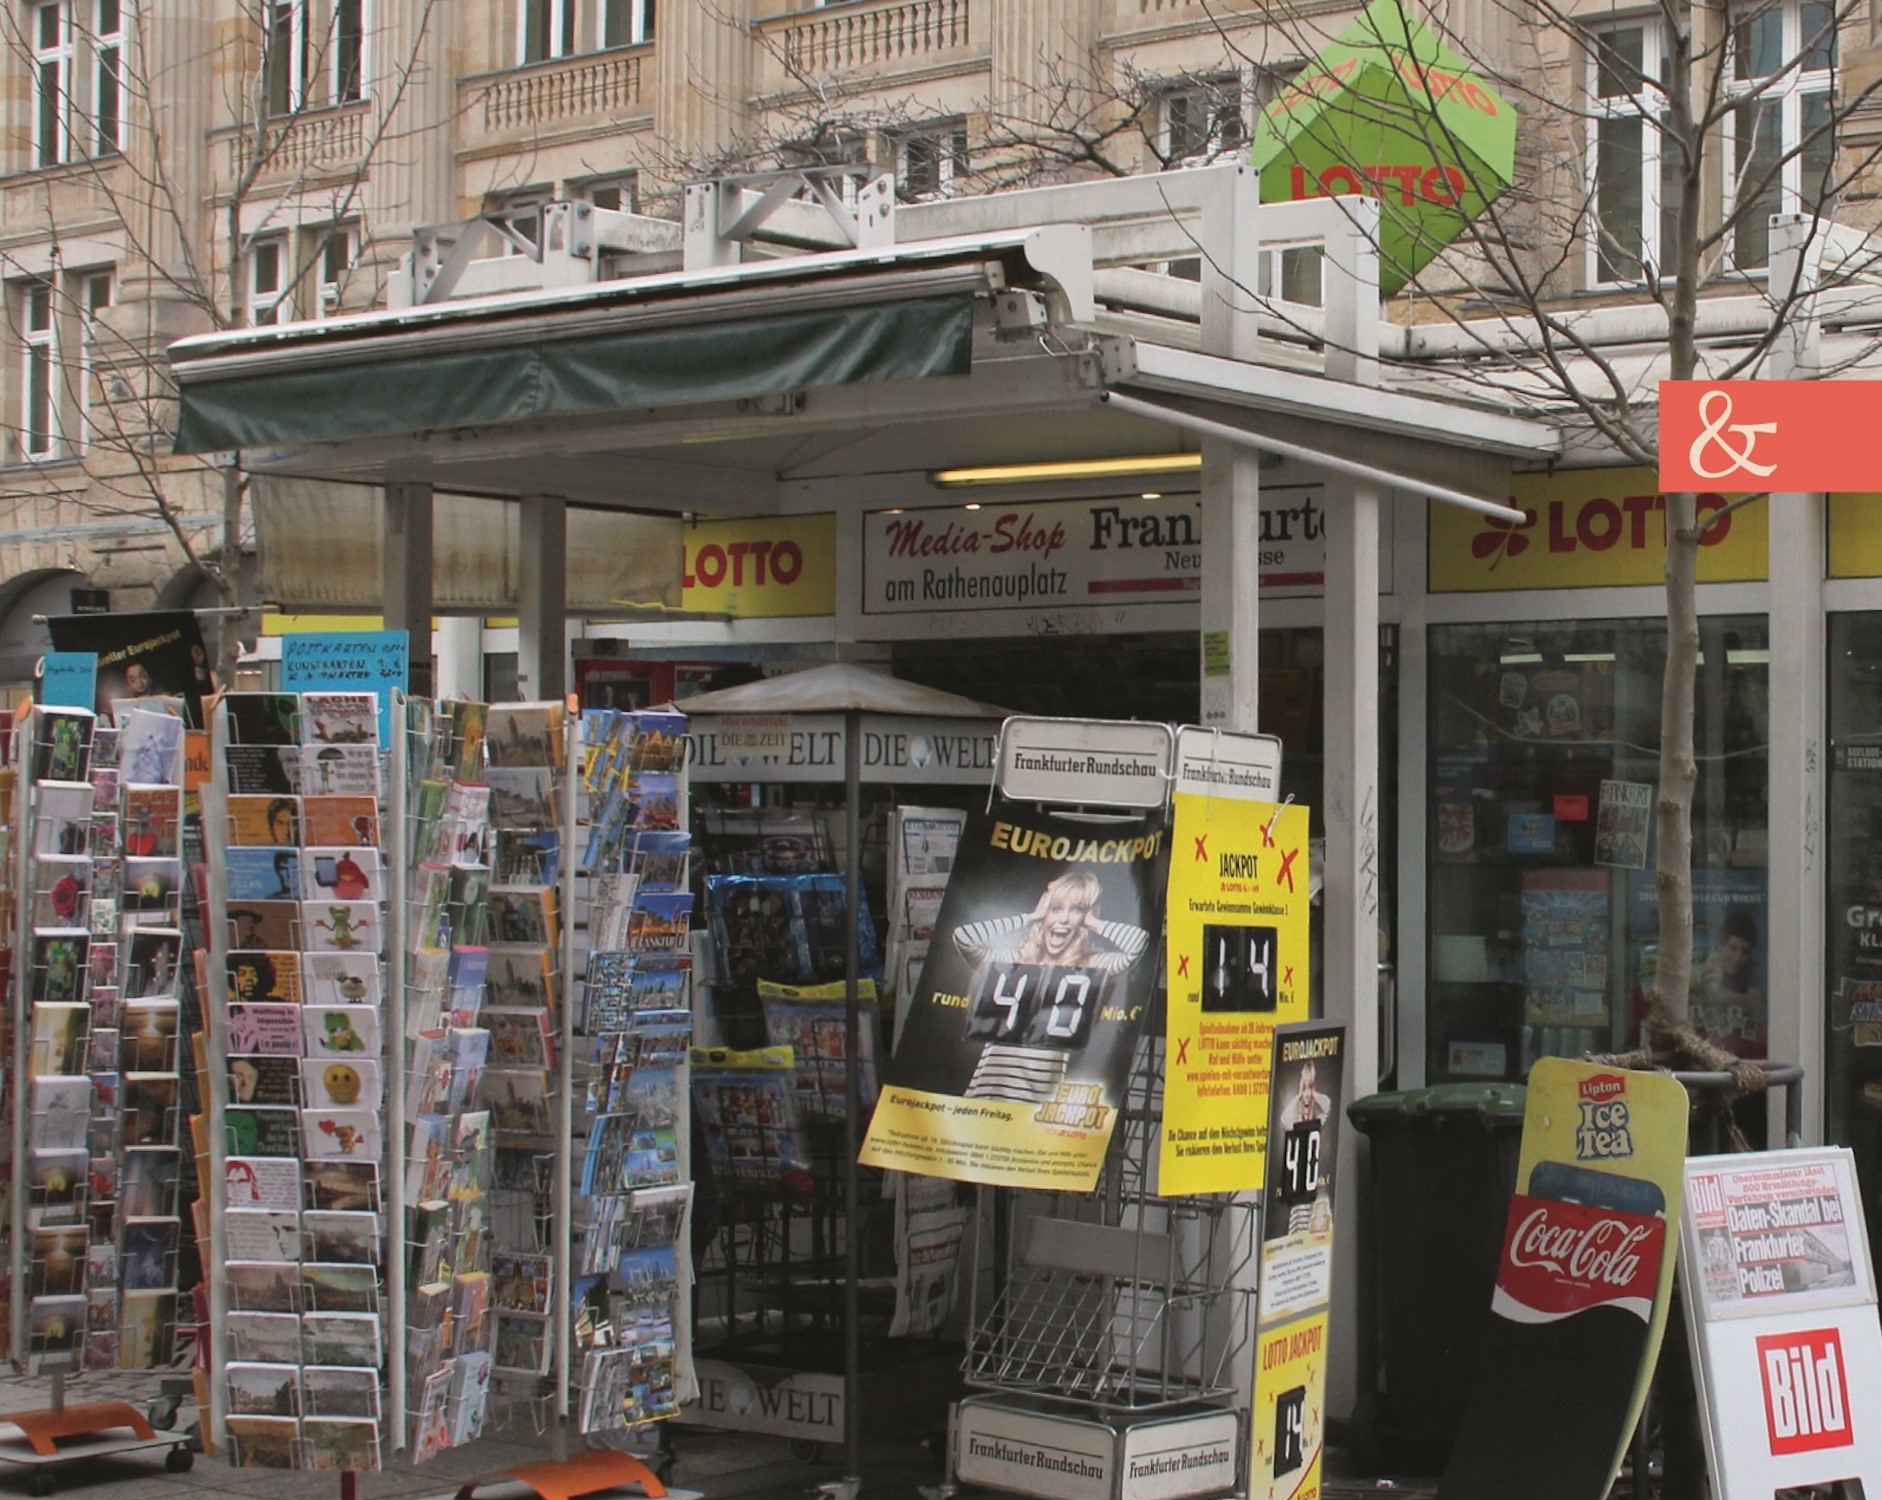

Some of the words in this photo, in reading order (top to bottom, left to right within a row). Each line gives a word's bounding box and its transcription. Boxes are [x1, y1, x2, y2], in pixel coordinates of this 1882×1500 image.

[1391, 55, 1498, 117] LOTTO
[1290, 164, 1465, 207] LOTTO
[885, 513, 1067, 561] Media-Shop
[682, 540, 803, 588] LOTTO
[1164, 551, 1201, 570] Neu
[886, 579, 915, 601] am
[923, 563, 1067, 601] Rathenauplatz
[721, 733, 743, 747] DIE
[759, 733, 786, 747] ZEIT
[864, 732, 908, 767] DIE
[932, 735, 996, 769] WELT
[1014, 753, 1087, 774] Frankfurter
[1086, 761, 1157, 777] Rundschau
[1228, 768, 1271, 789] Rundschau
[990, 821, 1164, 863] EUROJACKPOT
[1220, 853, 1258, 878] JACKPOT
[1189, 898, 1215, 912] Erwartete
[1216, 900, 1251, 914] Gewinnsumme
[1252, 901, 1284, 916] Gewinnklasse
[932, 992, 970, 1009] rund
[993, 973, 1091, 1038] 40
[1100, 1006, 1127, 1021] Mio.
[1253, 1037, 1272, 1049] mache
[1283, 1036, 1339, 1062] EUROJACKPOT
[1058, 1084, 1103, 1105] EURO
[1582, 1081, 1620, 1096] Lipton
[890, 1094, 945, 1113] Eurojackpot
[952, 1105, 979, 1118] jeden
[980, 1107, 1014, 1122] Freitag.
[1036, 1104, 1109, 1129] JACKPOT
[1581, 1102, 1627, 1129] Ice
[1579, 1129, 1632, 1158] Tea
[1732, 1169, 1804, 1184] Oberkommissar
[1762, 1178, 1819, 1191] Ermittlungs-
[1727, 1192, 1774, 1204] Verfahren
[1776, 1186, 1838, 1199] verschwinden
[1729, 1198, 1821, 1231] Daten-Skandal
[1821, 1196, 1842, 1222] bei
[1510, 1208, 1653, 1286] Coca-Cola
[1734, 1231, 1806, 1263] Frankfurter
[1739, 1265, 1785, 1294] Polizei
[1263, 1337, 1288, 1370] LOTTO
[1288, 1325, 1322, 1361] JACKPOT
[1765, 1342, 1845, 1438] Bild
[757, 1384, 840, 1426] WELT
[969, 1438, 1037, 1468] Frankfurter
[1036, 1451, 1104, 1480] Rundschau
[1129, 1457, 1181, 1479] Frankfurter
[1181, 1448, 1229, 1471] Rundschau
